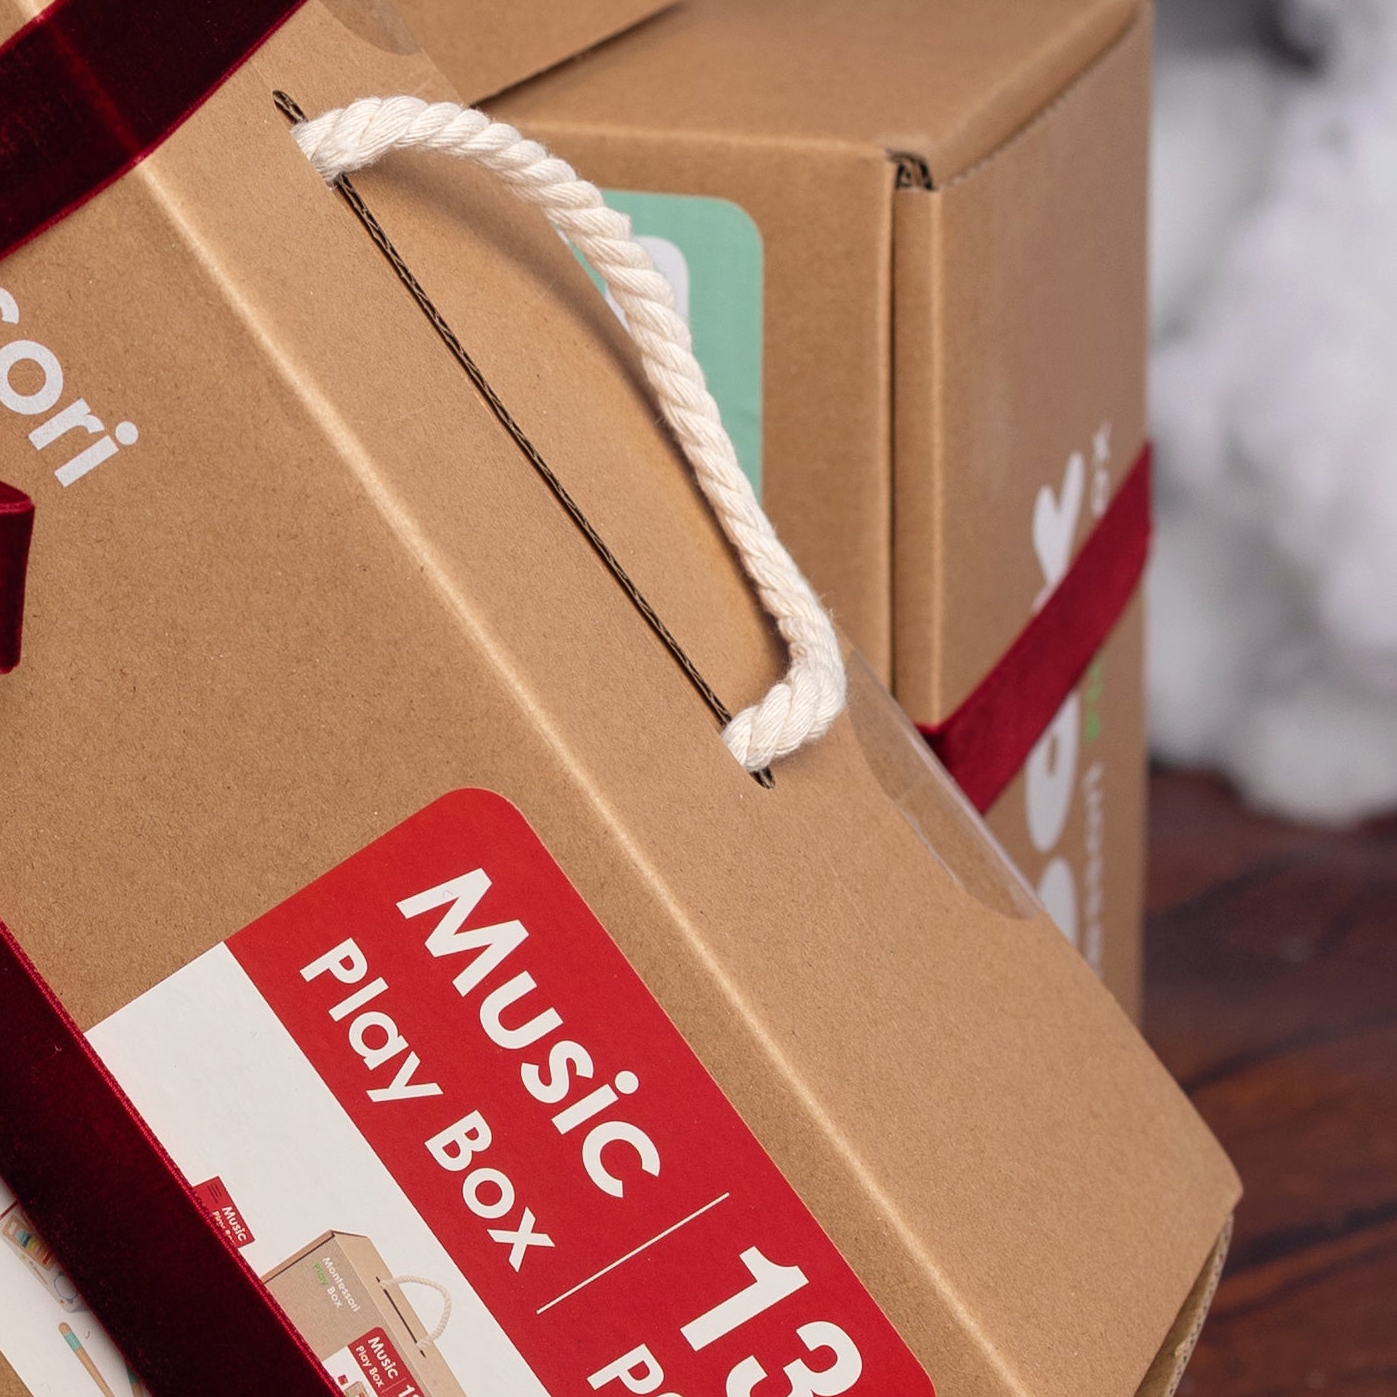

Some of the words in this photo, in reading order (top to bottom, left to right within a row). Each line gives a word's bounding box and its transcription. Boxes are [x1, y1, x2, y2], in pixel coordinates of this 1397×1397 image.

[396, 867, 661, 1198] Music
[299, 937, 444, 1103] Play
[424, 1110, 555, 1272] Box
[222, 1206, 247, 1242] Music
[326, 1285, 343, 1309] Box
[355, 1345, 372, 1368] Play
[369, 1366, 385, 1388] Box
[367, 1336, 399, 1379] Music
